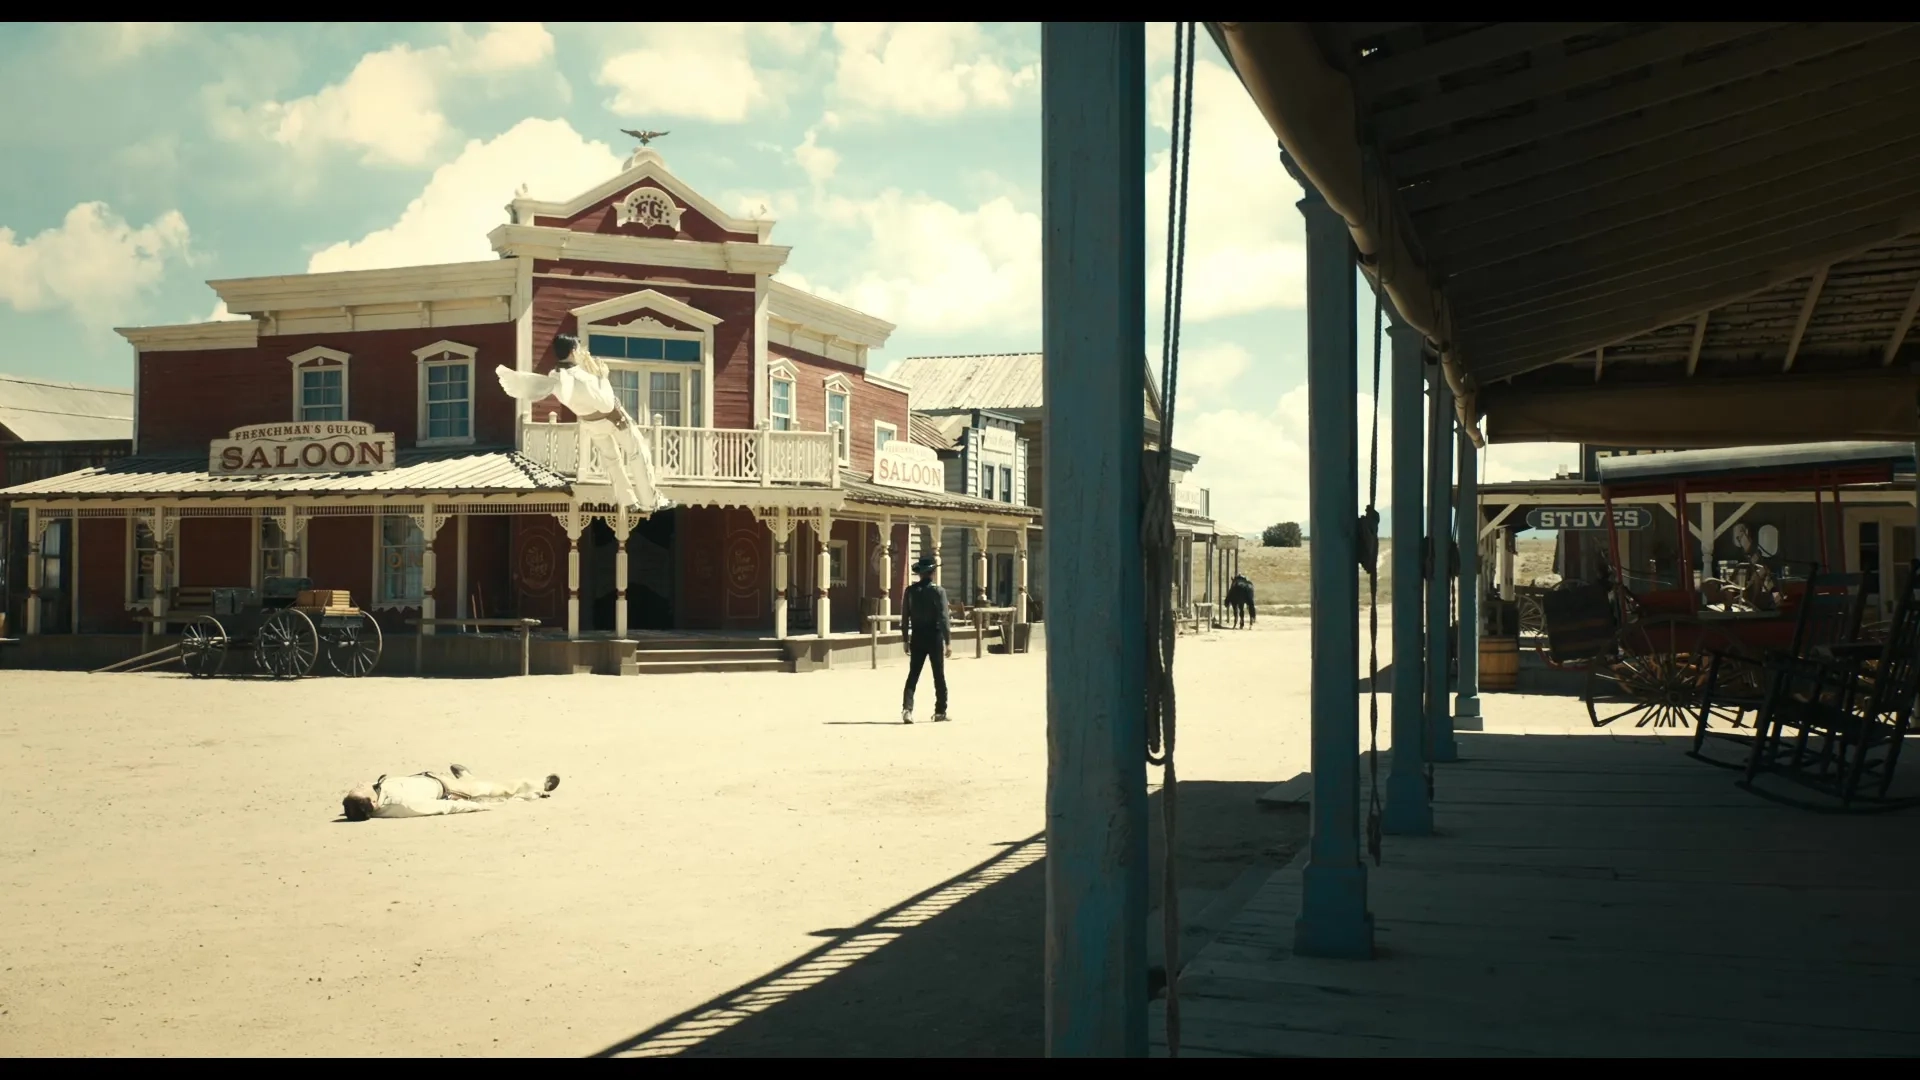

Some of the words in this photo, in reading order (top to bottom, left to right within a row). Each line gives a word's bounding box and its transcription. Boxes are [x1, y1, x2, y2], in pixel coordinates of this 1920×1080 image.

[635, 200, 664, 219] FG
[235, 424, 322, 441] FRENCHMAN'S
[327, 423, 368, 436] GULCH
[221, 441, 386, 471] SALOON
[879, 458, 941, 487] SALOON
[1540, 510, 1639, 527] STOVES
